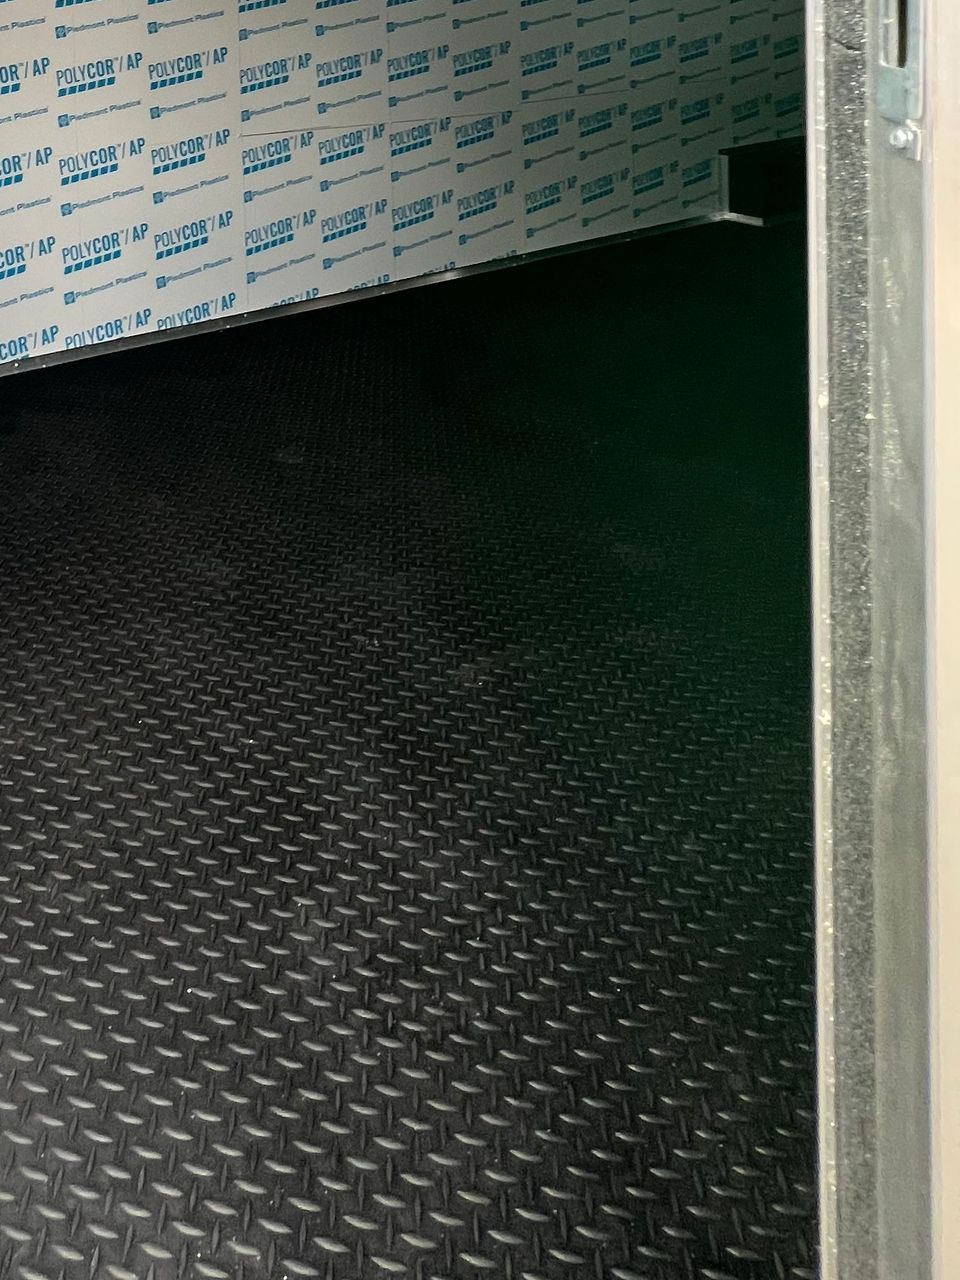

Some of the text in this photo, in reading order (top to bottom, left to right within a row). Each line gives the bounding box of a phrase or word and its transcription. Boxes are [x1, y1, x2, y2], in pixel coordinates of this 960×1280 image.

[32, 56, 50, 76] AP
[298, 52, 311, 69] AP
[215, 128, 230, 147] AP
[163, 182, 199, 198] Piedmont
